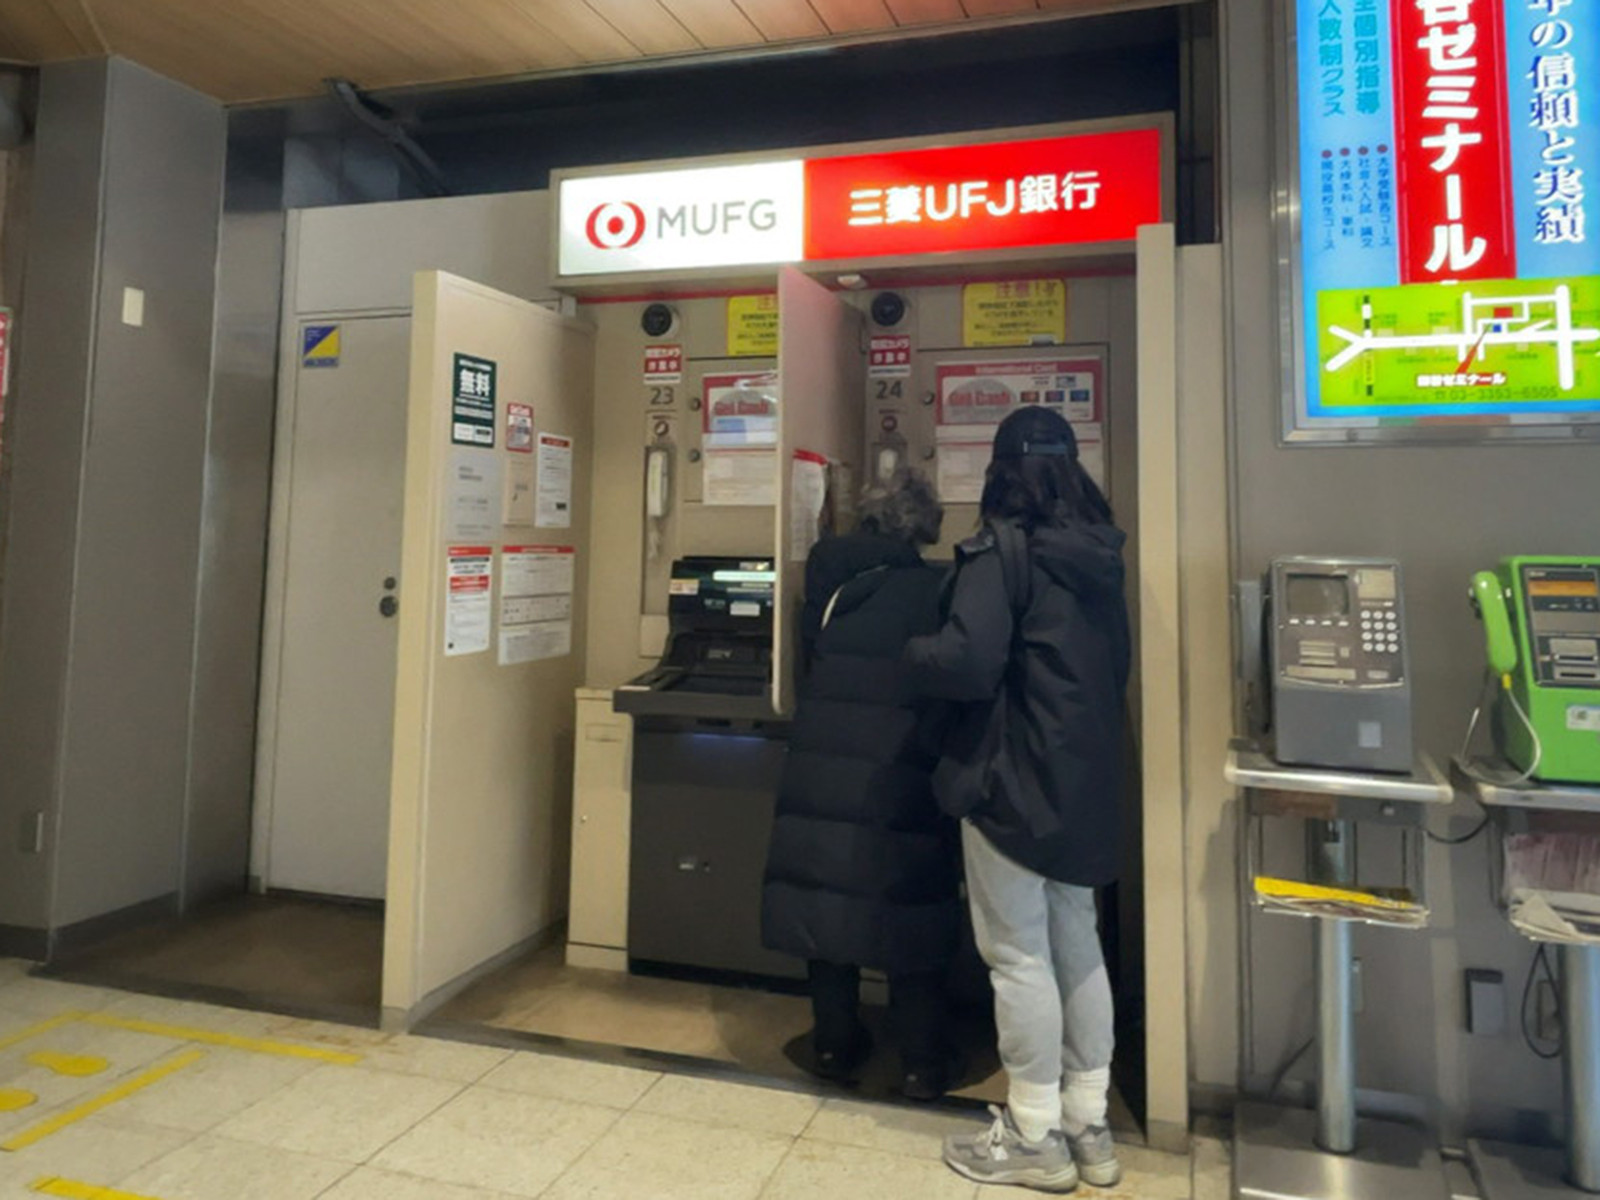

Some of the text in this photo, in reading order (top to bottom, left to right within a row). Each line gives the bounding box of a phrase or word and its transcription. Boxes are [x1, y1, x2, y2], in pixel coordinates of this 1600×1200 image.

[847, 171, 1101, 226] 三菱UFJ銀行
[656, 198, 777, 239] MUFG
[459, 367, 491, 397] 無料
[649, 386, 675, 406] 23
[875, 380, 903, 400] 24
